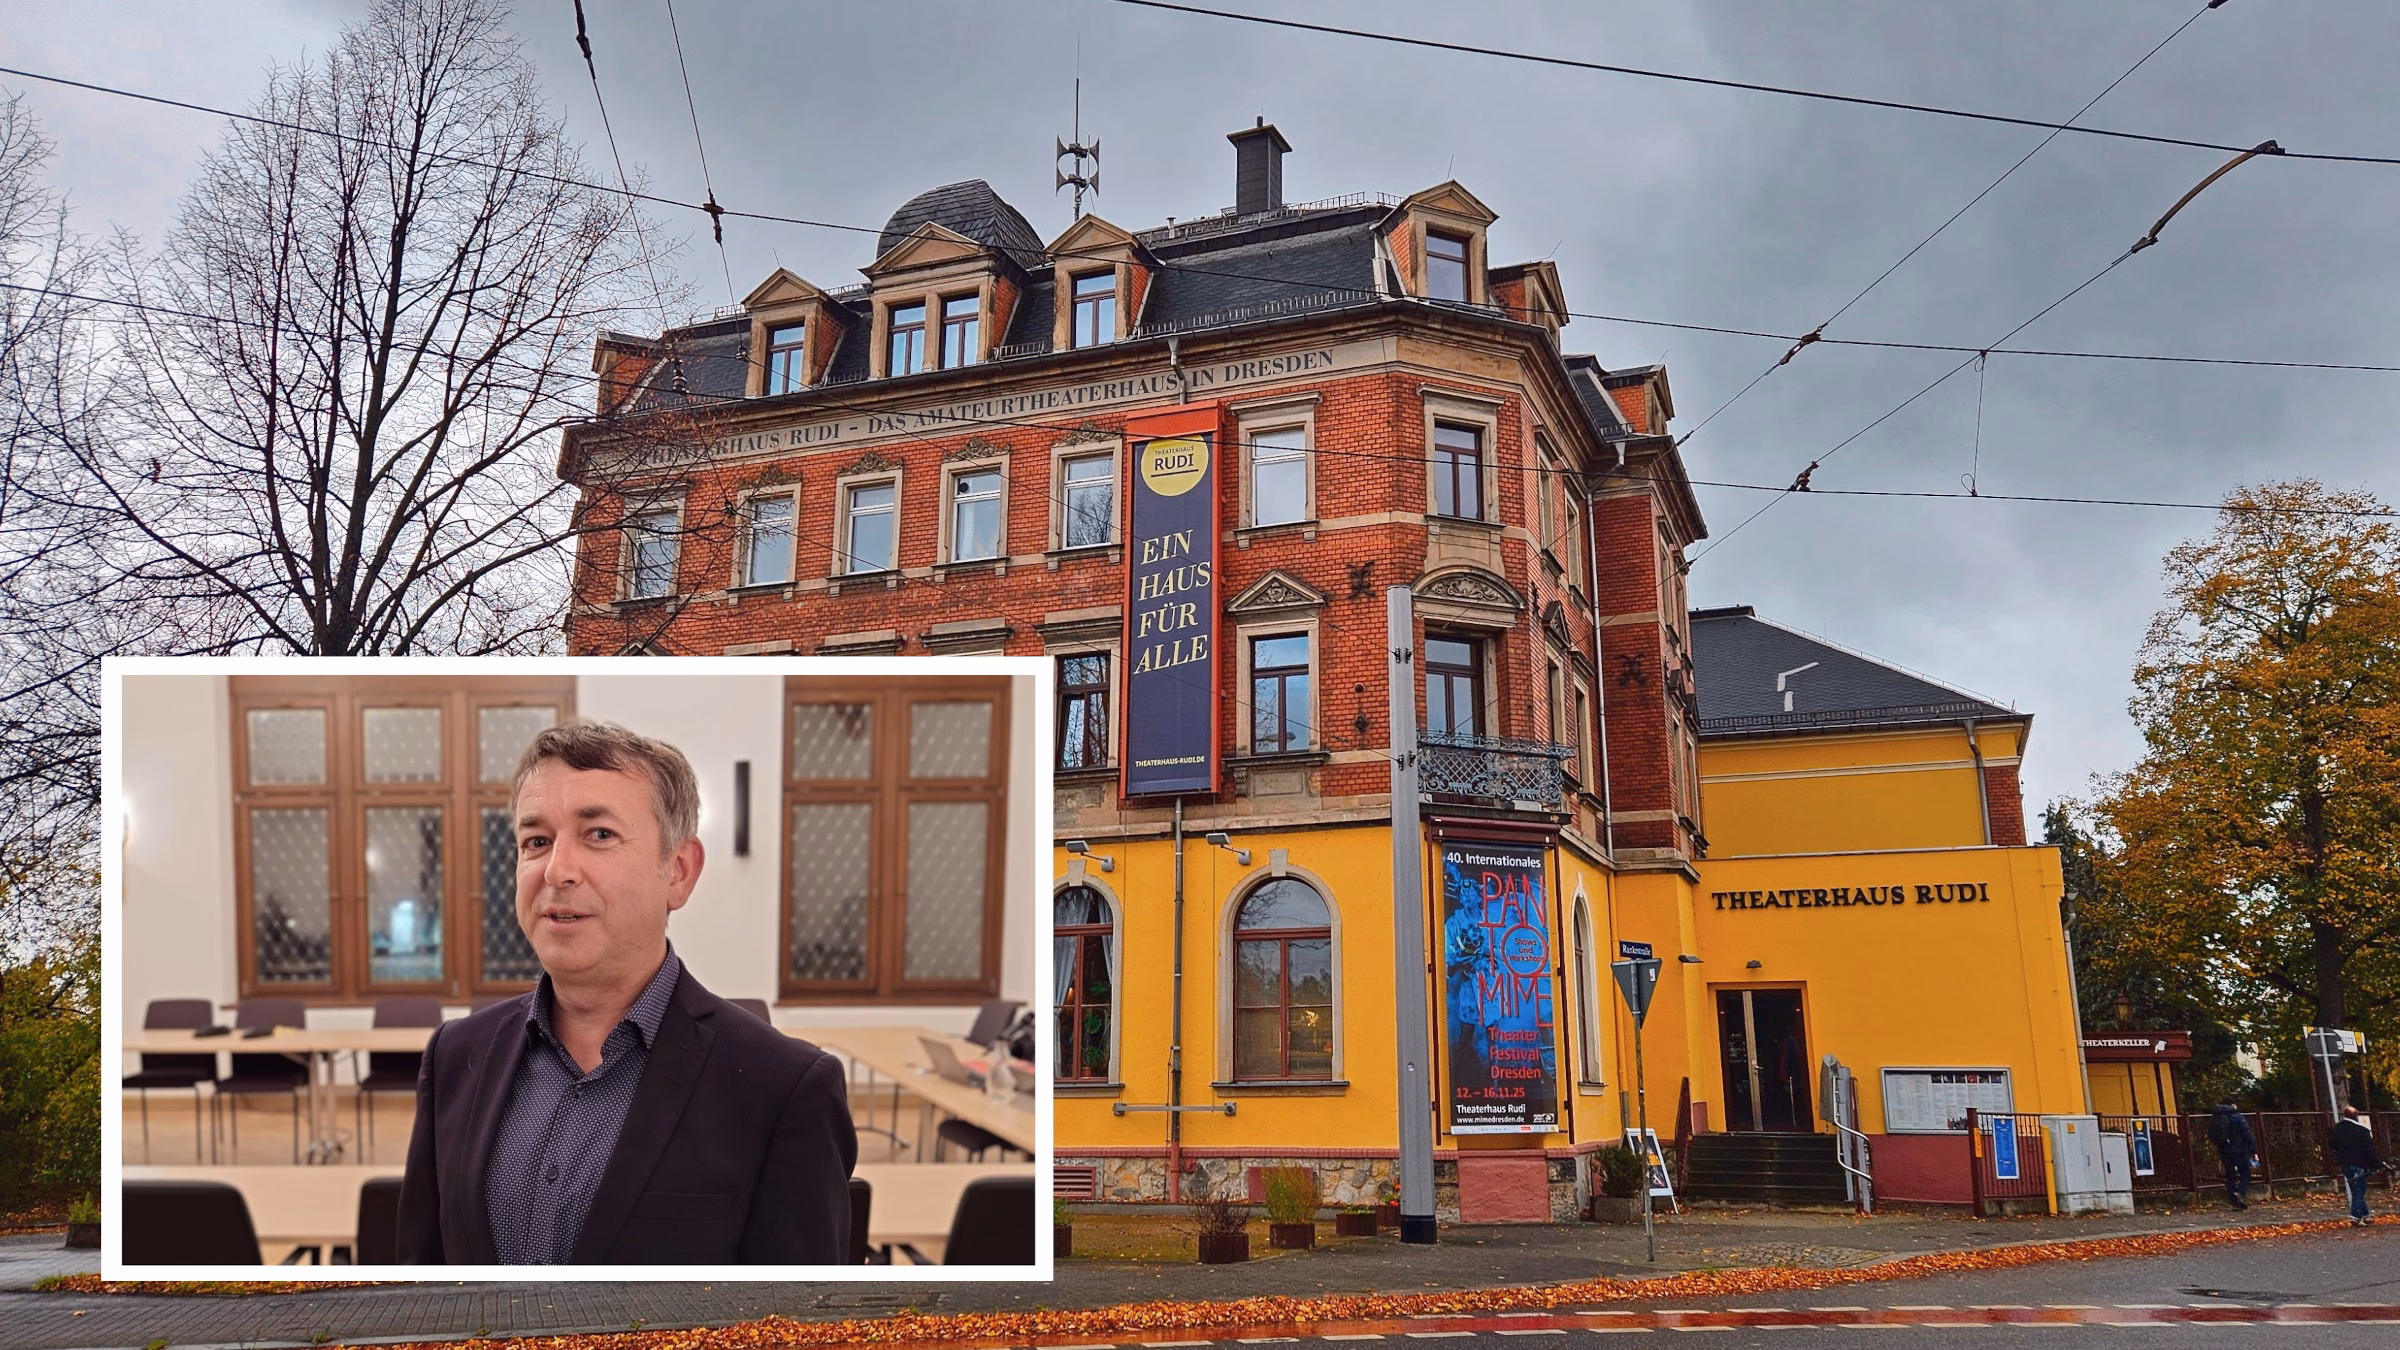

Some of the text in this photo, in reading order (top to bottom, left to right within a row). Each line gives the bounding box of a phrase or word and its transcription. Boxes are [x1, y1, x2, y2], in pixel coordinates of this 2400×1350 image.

[790, 423, 840, 445] RUDI
[868, 413, 906, 434] DAS
[913, 373, 1179, 428] AMATEURTHEATERHAUS
[1192, 367, 1215, 387] IN
[1223, 350, 1334, 382] DRESDEN
[1155, 445, 1194, 455] THEATERHAUS
[1154, 453, 1194, 471] RUDI
[1140, 529, 1193, 565] EIN
[1138, 561, 1211, 601] HAUS
[1137, 601, 1198, 639] FÜR
[1133, 634, 1208, 675] ALLE
[1135, 755, 1205, 767] THEATERHAUS-RUDI.DE
[1447, 852, 1541, 868] 40. Internationales
[1482, 871, 1546, 927] PAN
[1711, 882, 1990, 910] THEATERHAUS RUDI
[1477, 922, 1548, 977] TO
[1515, 937, 1537, 946] Shows
[1478, 971, 1554, 1029] MIME
[1488, 1027, 1539, 1041] Theater
[2082, 1039, 2151, 1047] THEATERKELLER
[1490, 1046, 1540, 1060] Festival
[1491, 1066, 1541, 1079] Dresden
[1456, 1087, 1472, 1098] 12.
[1483, 1087, 1525, 1098] 16.11.25
[1456, 1104, 1526, 1114] Theaterhaus Rudi
[1456, 1116, 1525, 1124] www.mimedresden.de
